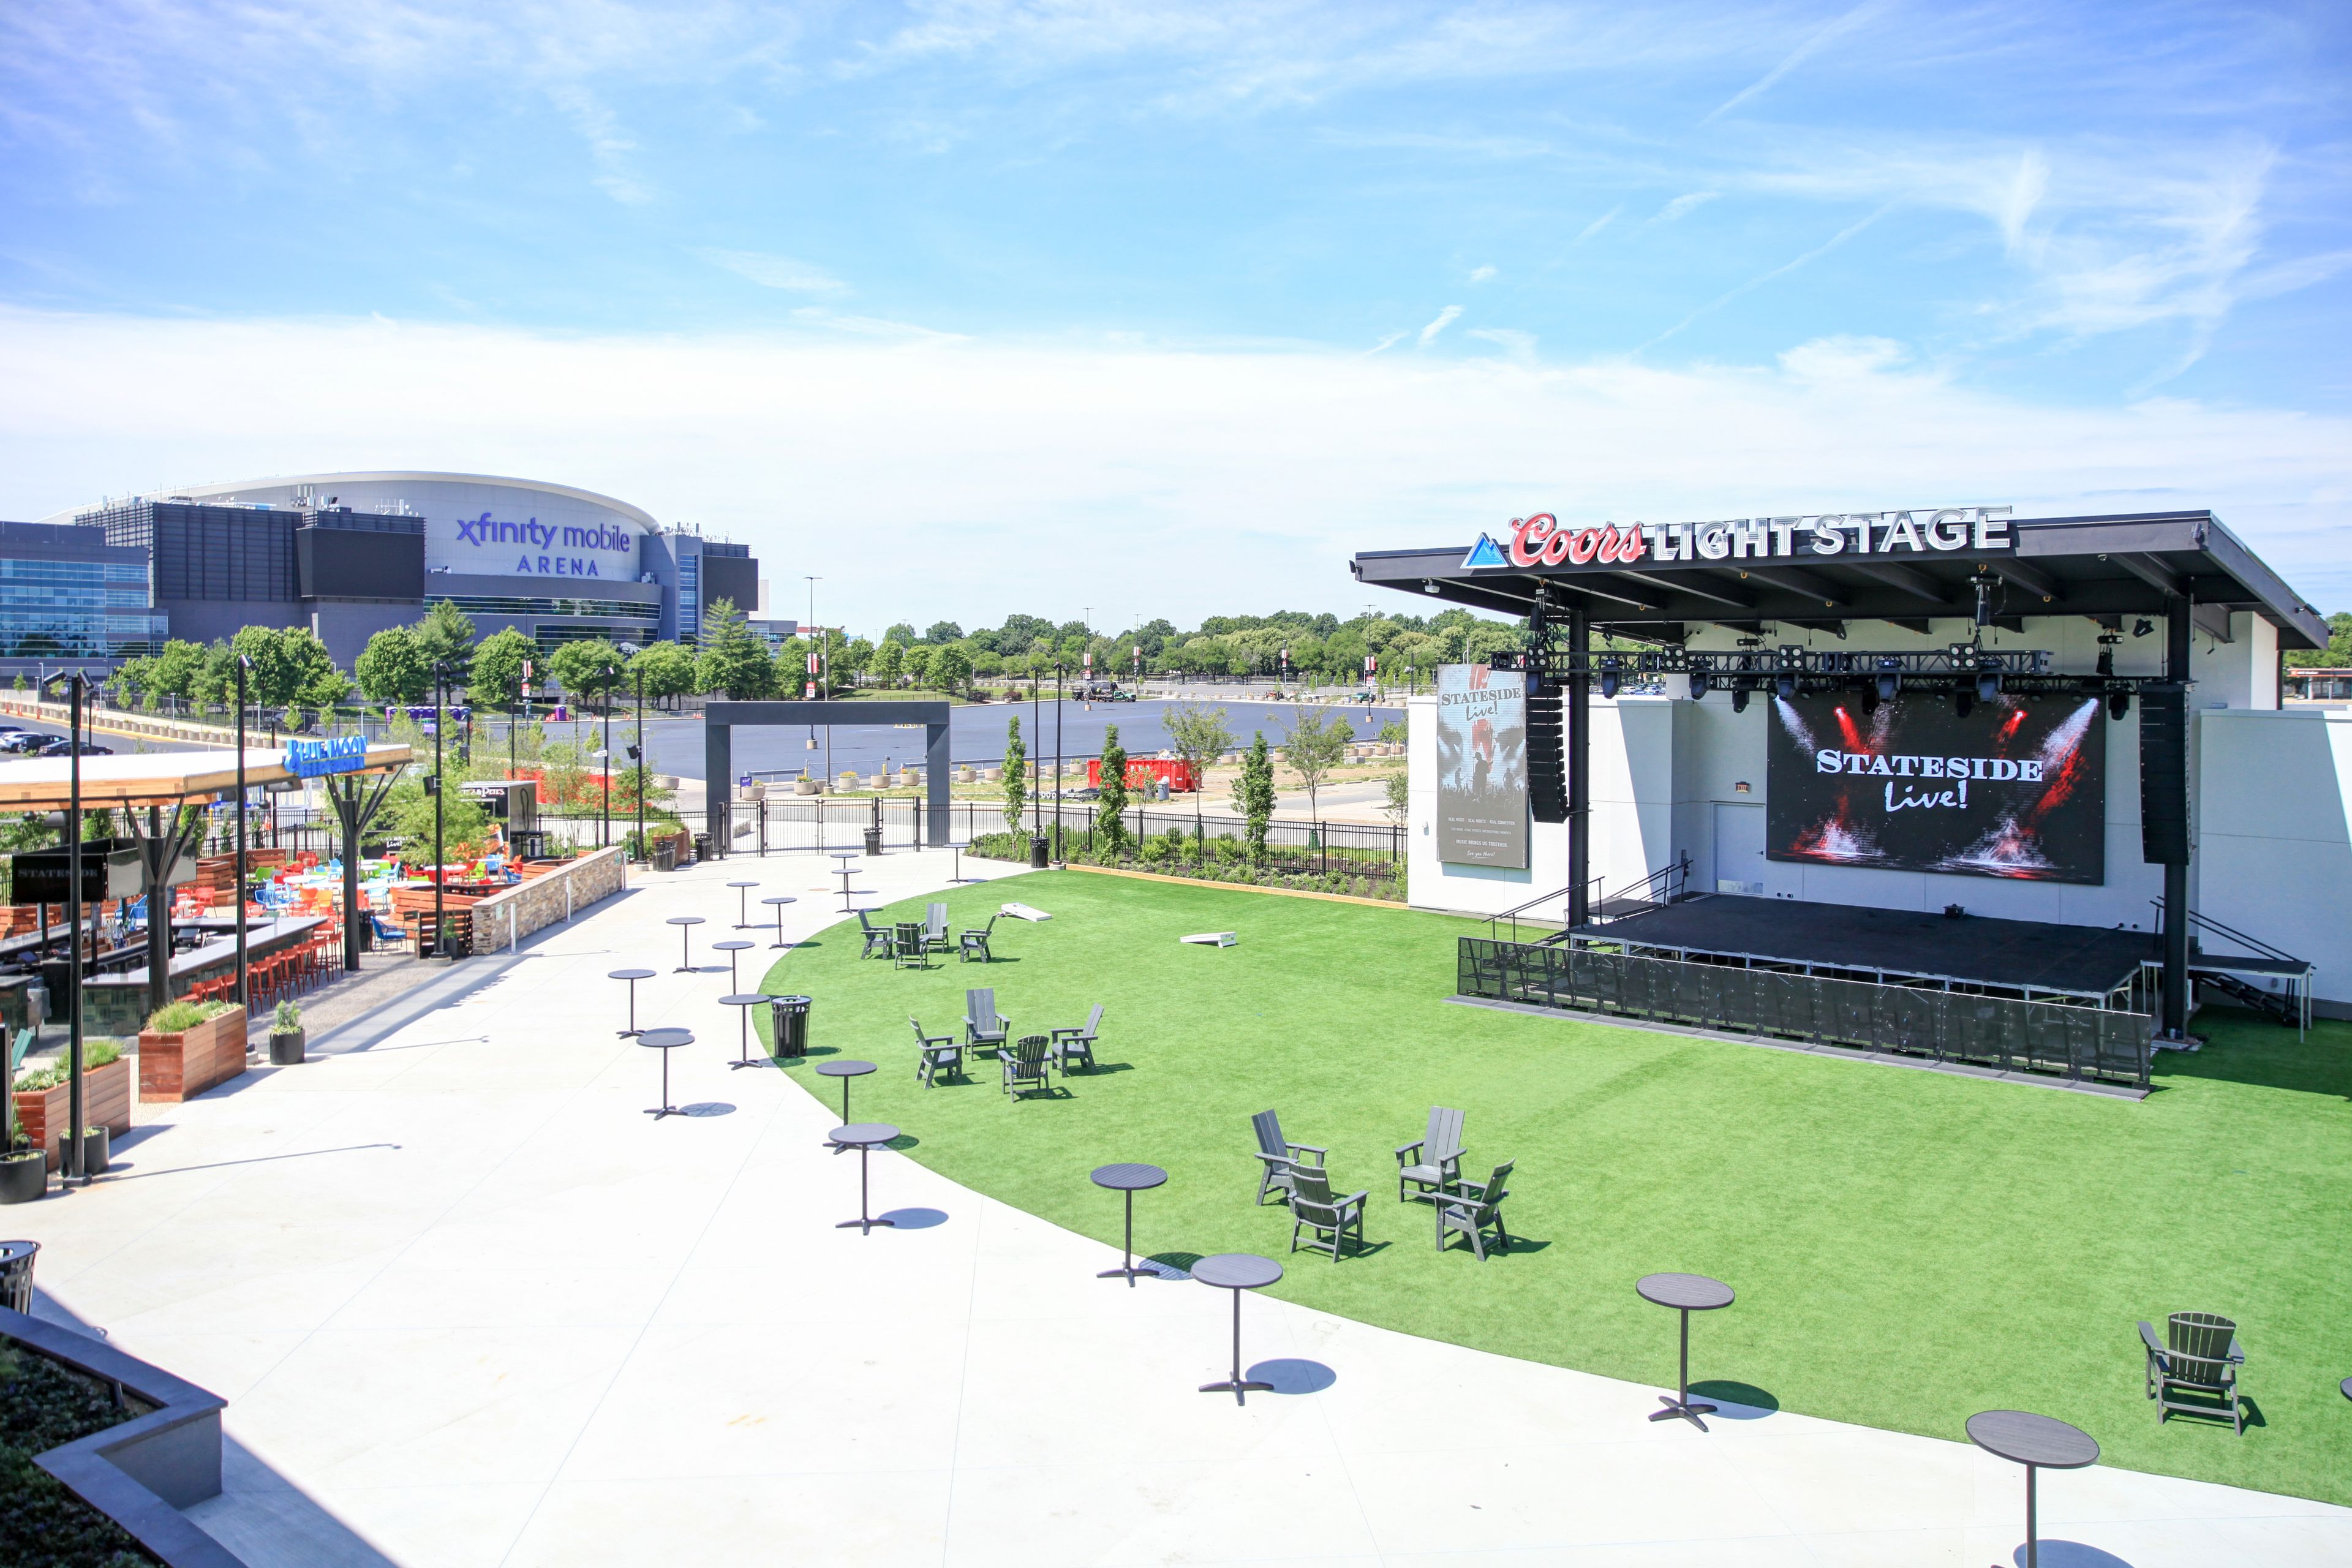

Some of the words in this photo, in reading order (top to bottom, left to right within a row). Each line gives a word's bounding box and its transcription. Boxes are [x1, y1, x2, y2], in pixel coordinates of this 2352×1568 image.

[456, 512, 558, 550] xfinity
[564, 523, 630, 552] mobile
[1508, 511, 1647, 568] Coors
[1654, 515, 1803, 561] LIGHT
[1812, 505, 2013, 556] STAGE
[516, 555, 599, 576] ARENA
[1441, 688, 1521, 706] STATESIDE
[1466, 700, 1498, 721] Live!
[1816, 748, 2043, 782] STATESIDE
[1884, 780, 1967, 812] Live!
[18, 869, 97, 877] STATESDE
